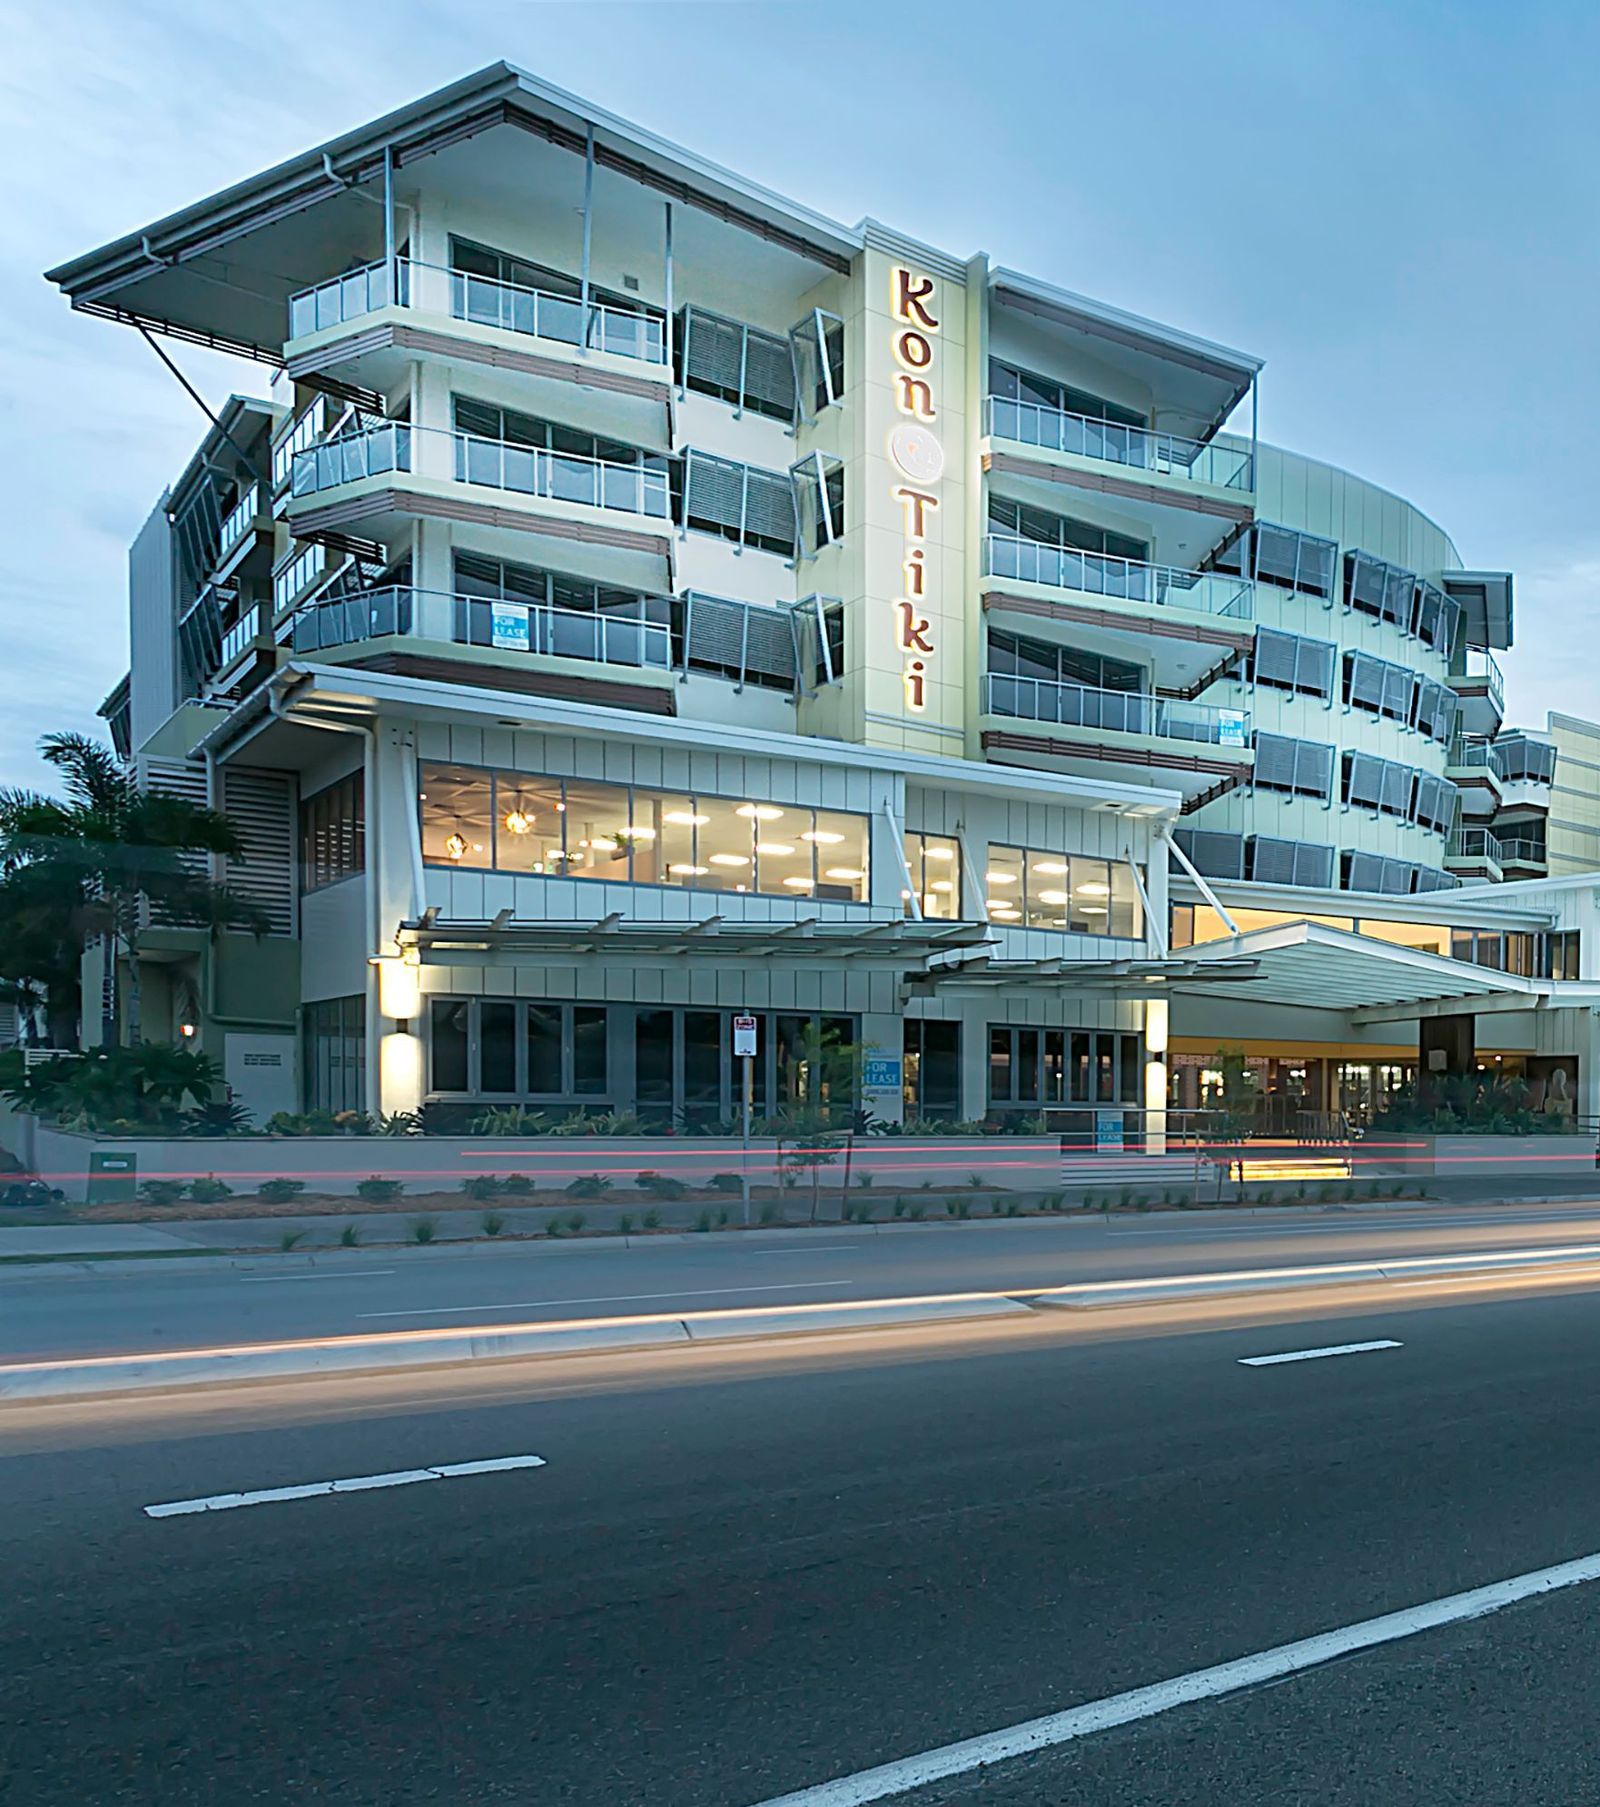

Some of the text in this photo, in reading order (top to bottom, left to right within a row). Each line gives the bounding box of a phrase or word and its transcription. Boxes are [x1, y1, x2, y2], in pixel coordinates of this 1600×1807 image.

[897, 269, 939, 707] Kon Tiki
[494, 615, 515, 627] FOR
[494, 626, 526, 638] LEASE
[866, 1073, 898, 1084] LEASE
